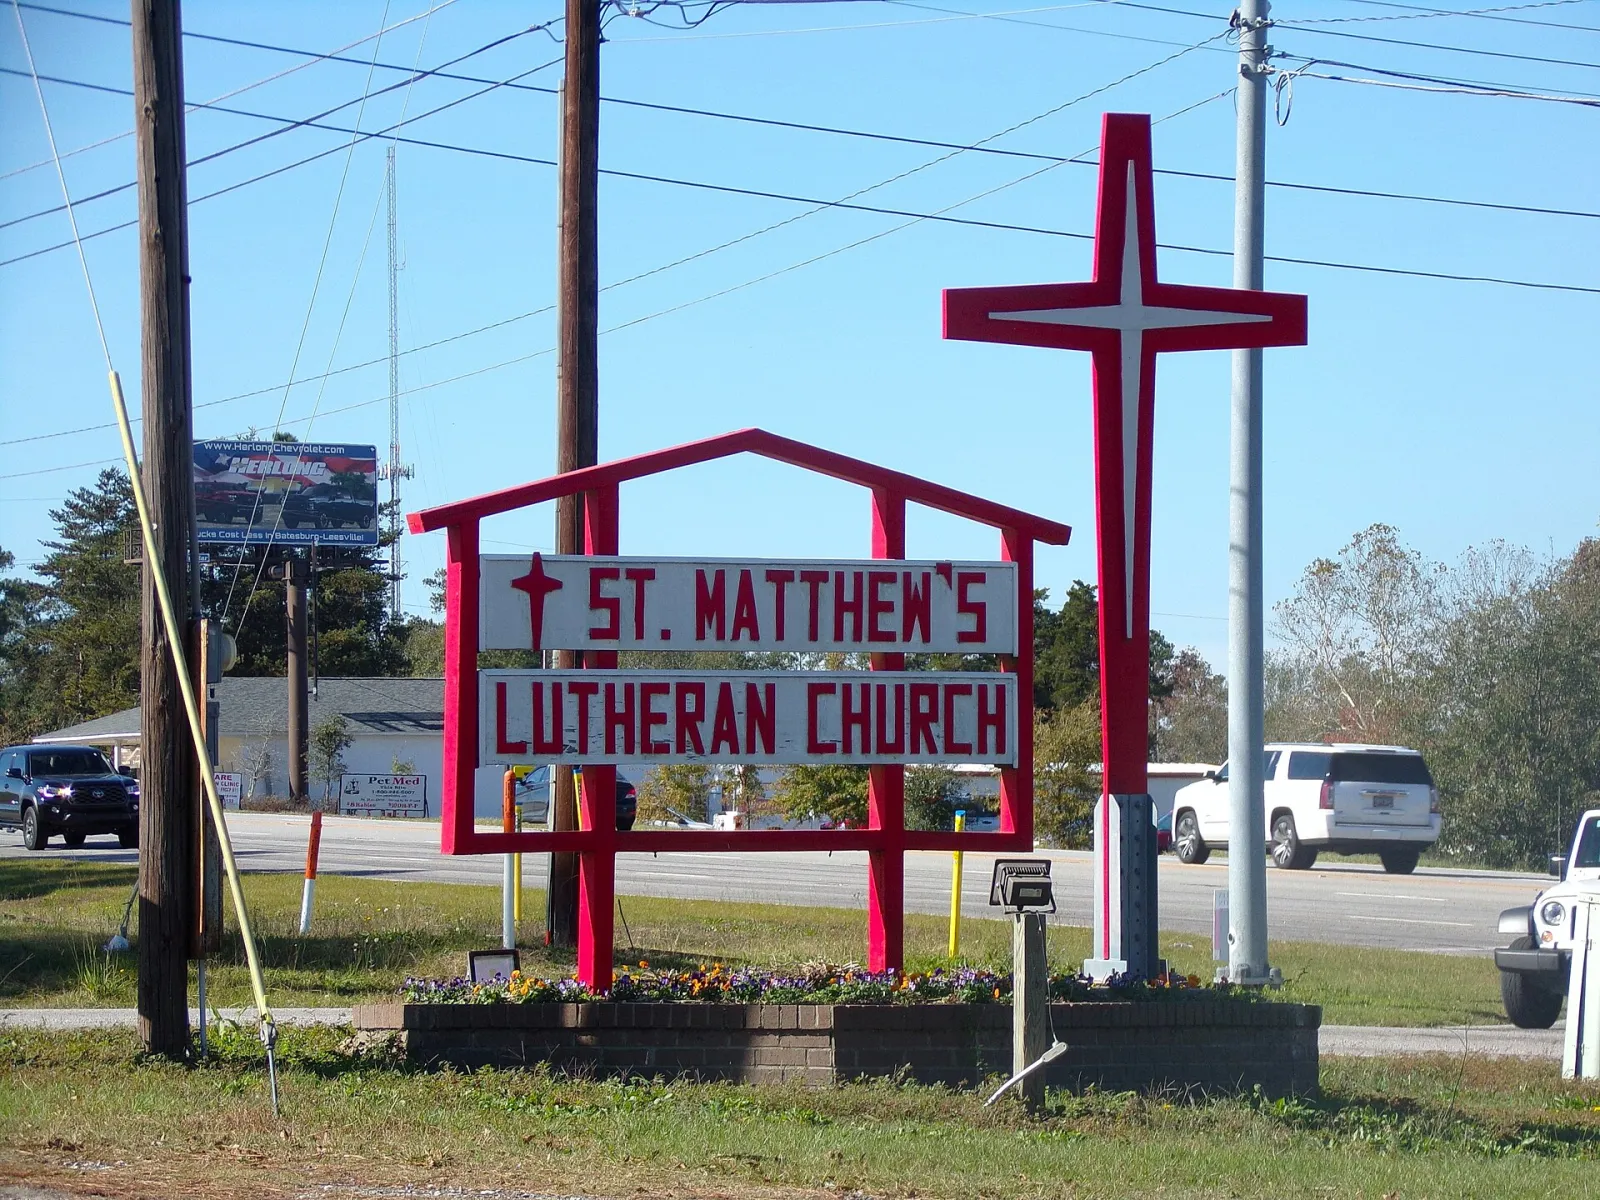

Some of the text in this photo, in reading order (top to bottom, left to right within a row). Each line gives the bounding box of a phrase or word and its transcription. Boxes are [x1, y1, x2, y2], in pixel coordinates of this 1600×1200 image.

[204, 442, 345, 454] www.HerlongChevrolet.com
[228, 457, 327, 475] HERLONG
[218, 530, 240, 539] Cost
[241, 531, 263, 539] Less
[589, 562, 987, 643] ST. MATTHEW'S
[496, 681, 1006, 755] LUTHERAN CHURCH
